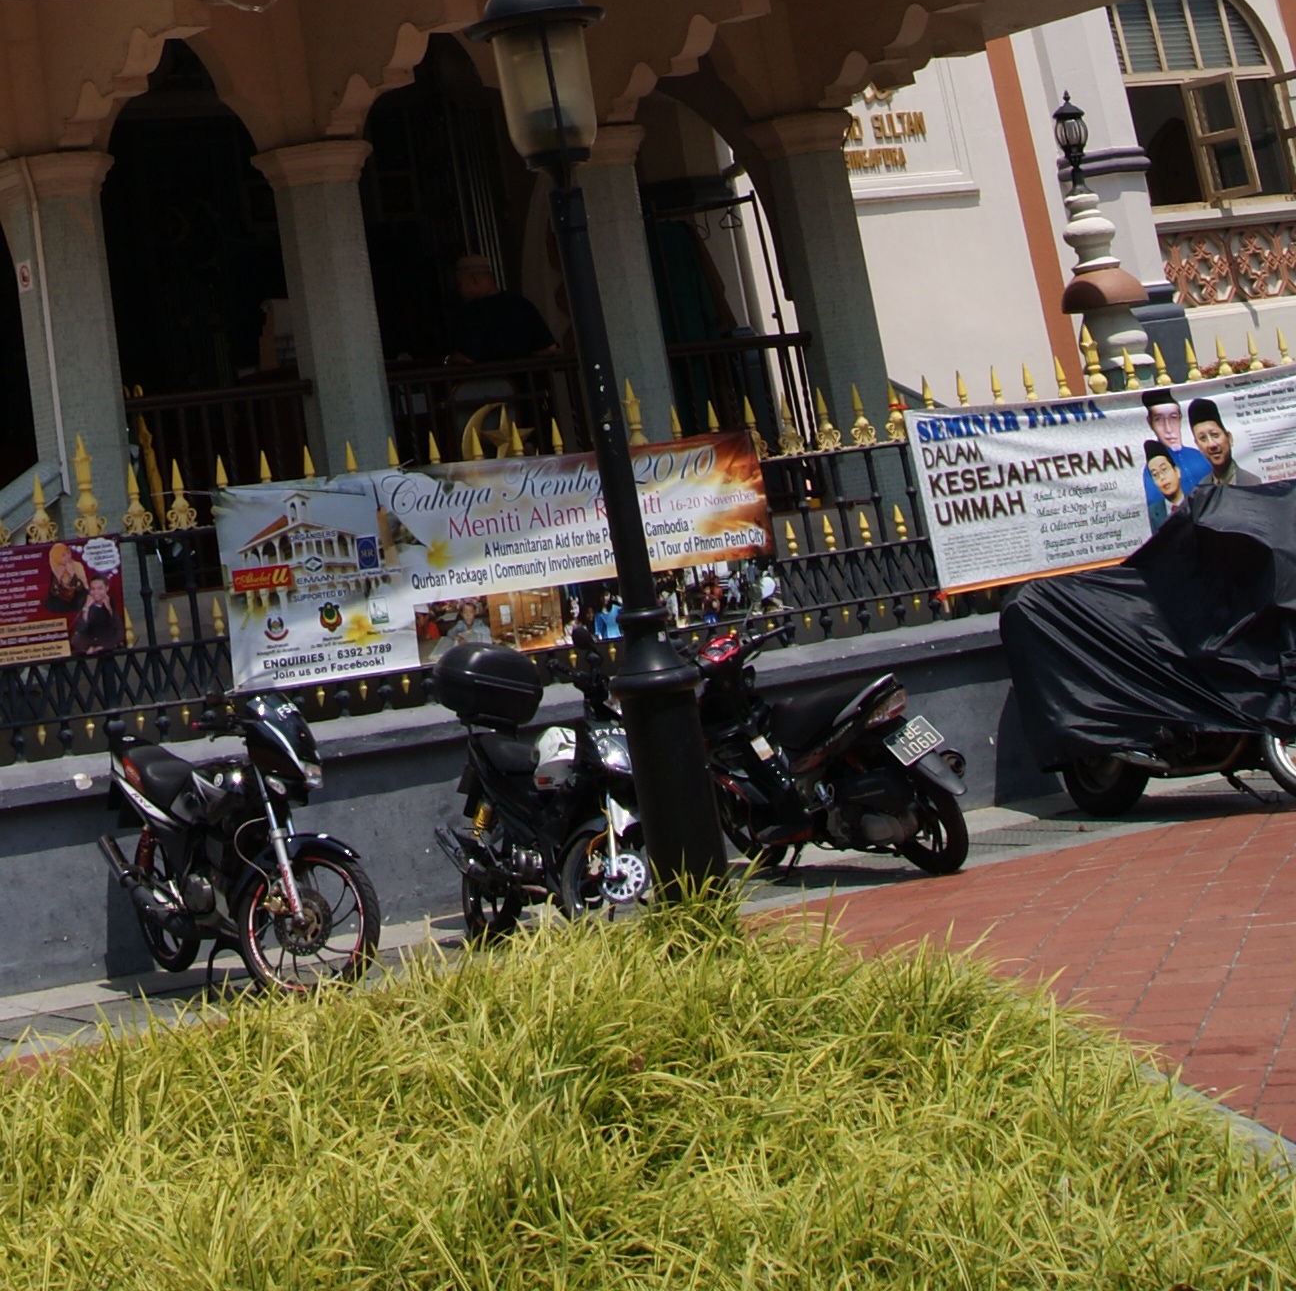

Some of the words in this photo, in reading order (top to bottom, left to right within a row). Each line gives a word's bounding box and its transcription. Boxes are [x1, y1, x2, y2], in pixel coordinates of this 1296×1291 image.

[871, 112, 927, 139] SULTAN
[916, 409, 1020, 443] SEMINAR
[1022, 399, 1106, 429] FATWA
[922, 440, 984, 469] DALAM
[928, 445, 1135, 498] KESEJAHTERAAN
[381, 474, 492, 515] Cahaya
[633, 446, 714, 485] 2010
[449, 509, 521, 539] Meniti
[529, 503, 587, 529] Alam
[669, 498, 701, 512] 16-20
[704, 490, 756, 507] November
[934, 490, 1026, 526] UMMAH
[484, 545, 492, 558] A
[493, 537, 554, 557] Humanitarian
[555, 532, 570, 548] Aid
[572, 530, 585, 546] for
[586, 528, 601, 544] the
[644, 517, 689, 537] Cambodia
[412, 571, 447, 590] Qurban
[448, 566, 488, 586] Package
[495, 559, 547, 579] Community
[548, 551, 603, 571] Involvement
[662, 540, 681, 556] Tour
[684, 537, 693, 552] of
[694, 533, 724, 551] Phnom
[725, 531, 748, 547] Penh
[748, 528, 765, 546] City
[293, 590, 335, 603] SUPPORTED
[337, 589, 348, 598] BY
[263, 652, 325, 670] ENQUIRIES
[337, 646, 363, 659] 6392
[366, 643, 392, 656] 3789
[272, 667, 295, 680] Join
[299, 666, 311, 676] us
[315, 664, 328, 674] on
[330, 657, 385, 673] Facebook!
[903, 731, 937, 757] 1060
